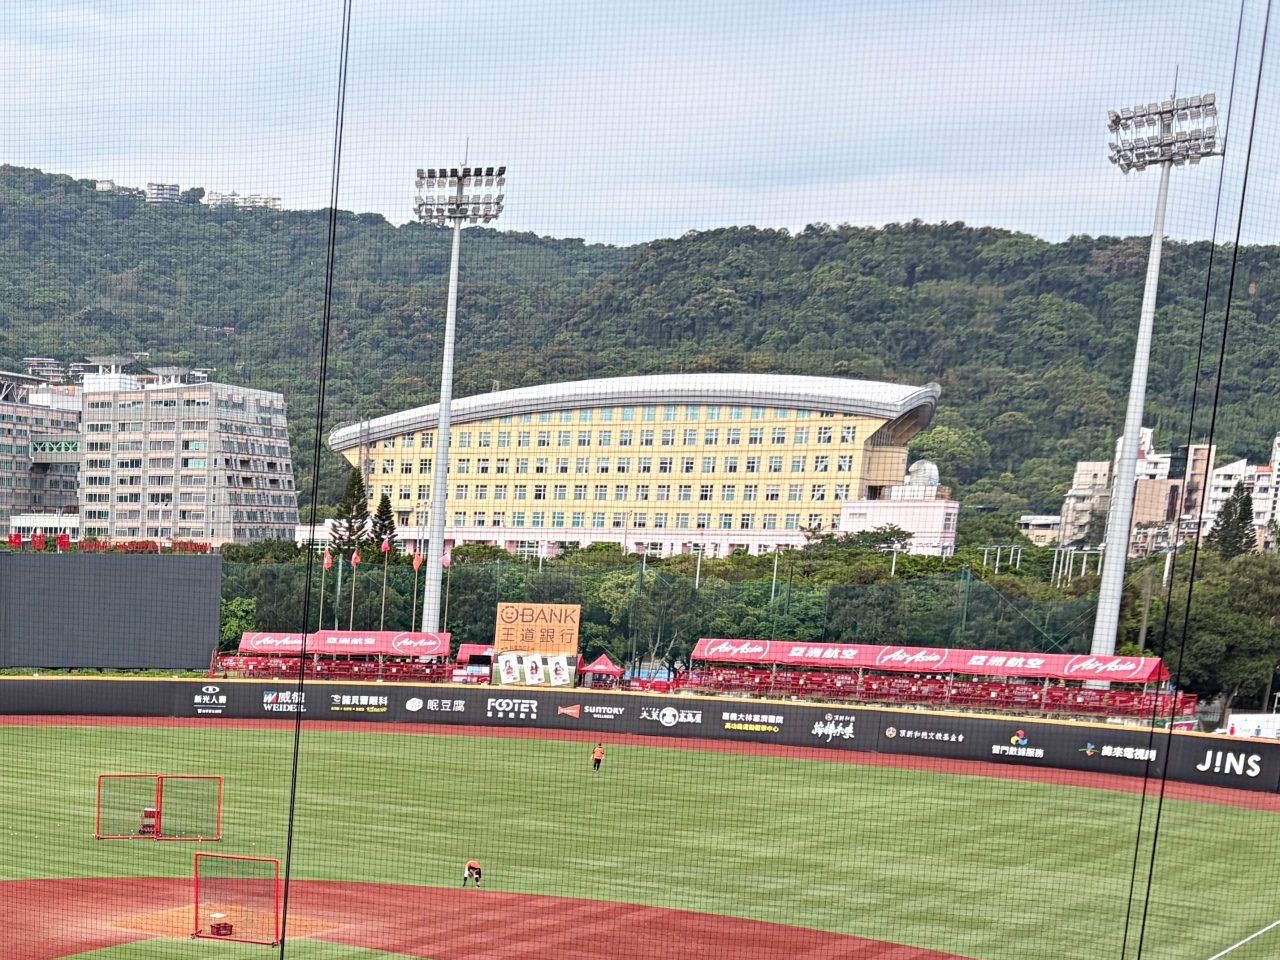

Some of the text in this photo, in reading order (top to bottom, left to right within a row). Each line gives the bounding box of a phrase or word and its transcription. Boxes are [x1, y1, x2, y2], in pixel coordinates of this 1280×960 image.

[501, 627, 575, 643] 王道銀行
[710, 641, 764, 655] AirAsia
[788, 646, 858, 659] 亞洲航空
[881, 649, 941, 664] AirAsia
[967, 655, 1045, 669] 亞洲航空
[1071, 658, 1136, 674] AirAsia
[427, 700, 465, 712] 眠豆腐
[488, 699, 538, 712] FOOTER
[584, 706, 624, 715] SUNTORY
